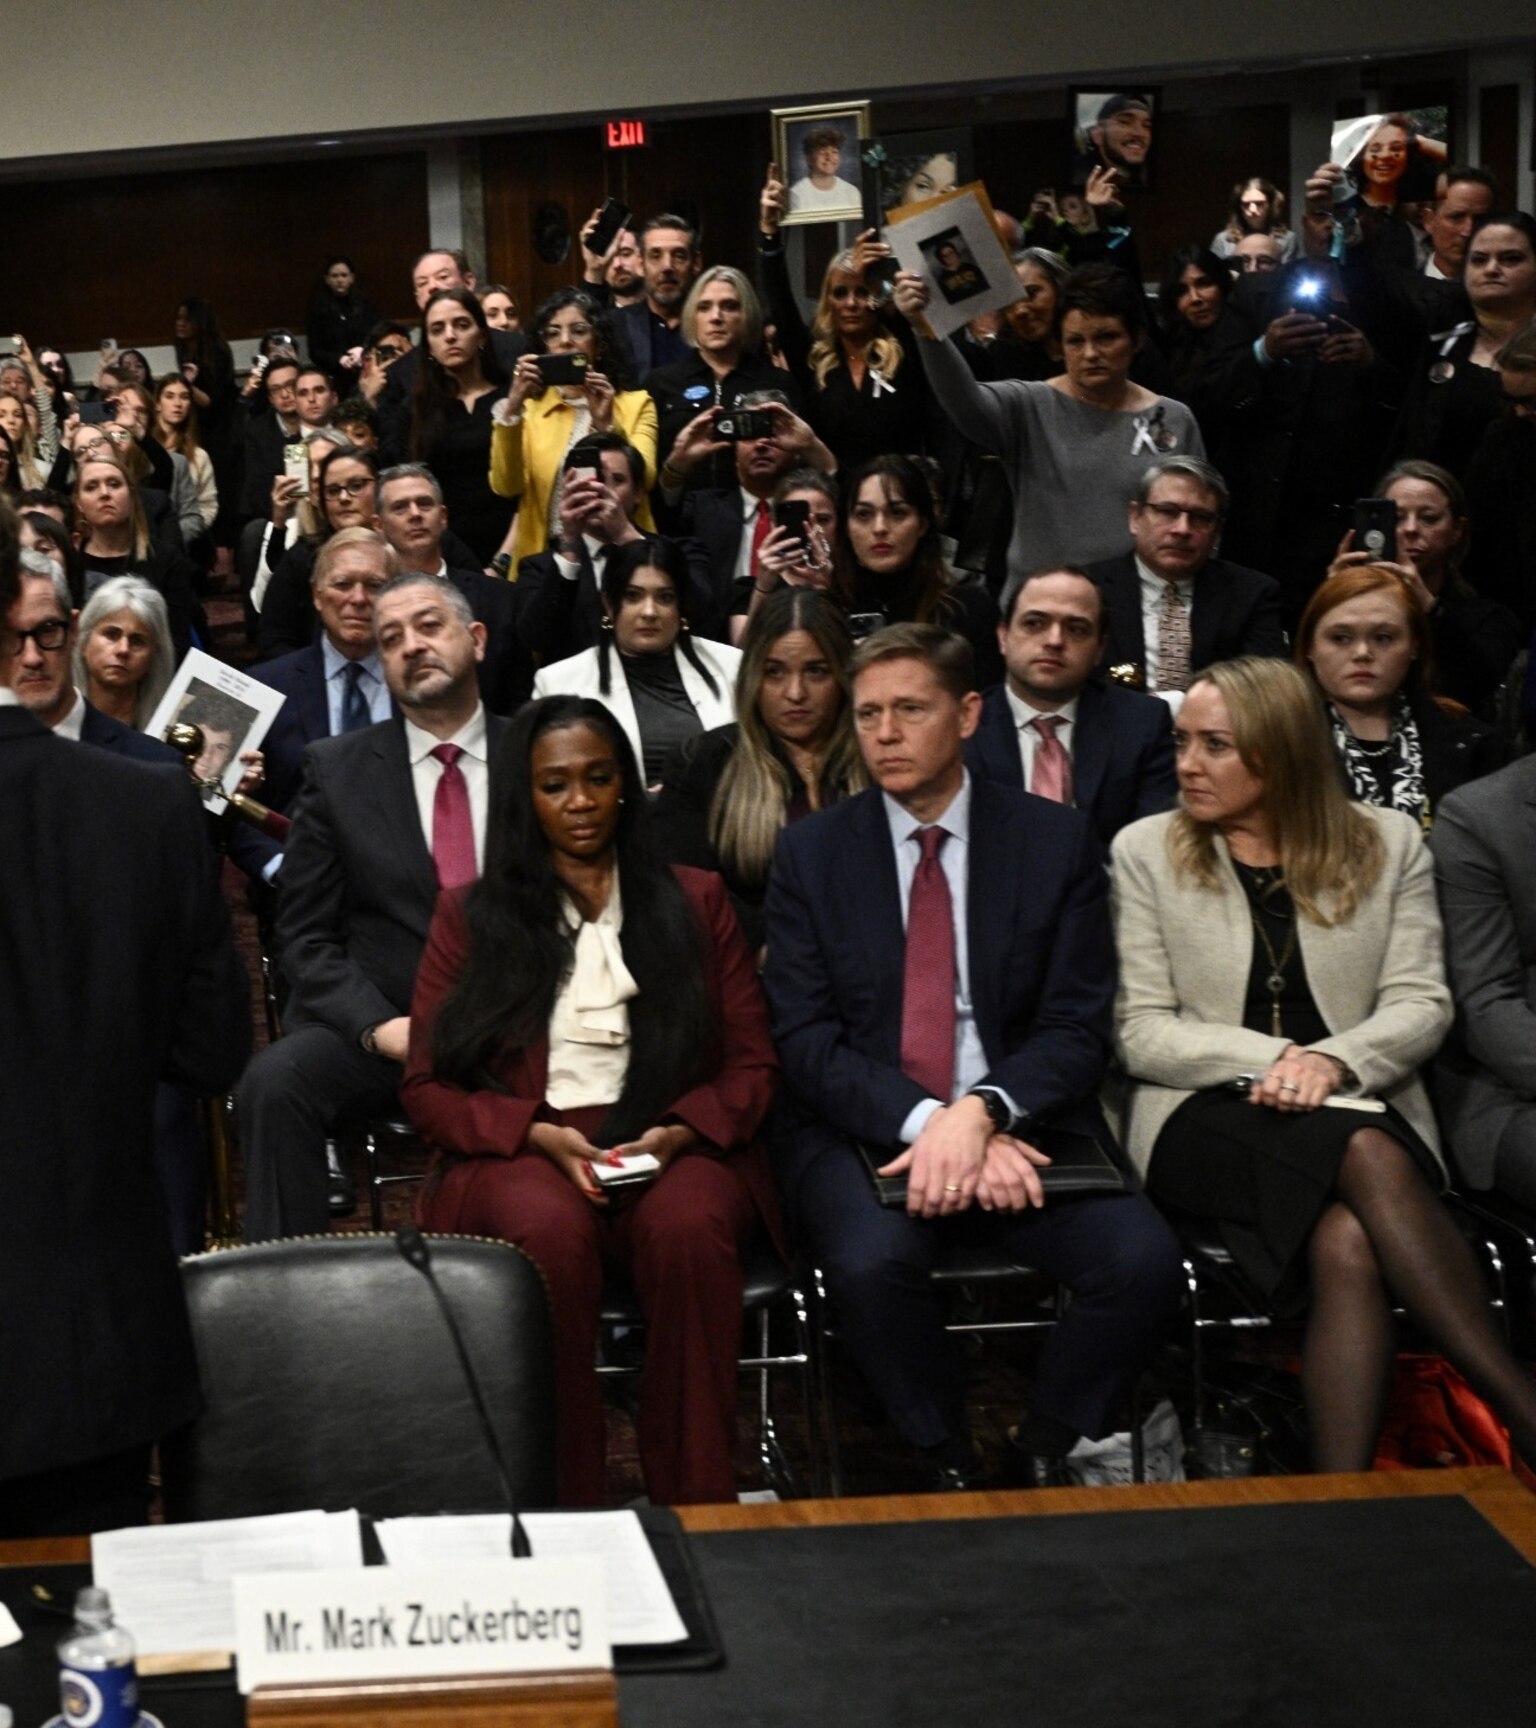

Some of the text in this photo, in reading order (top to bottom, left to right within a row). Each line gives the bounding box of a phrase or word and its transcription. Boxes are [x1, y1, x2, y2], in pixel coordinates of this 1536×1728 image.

[607, 121, 644, 147] EXIT
[265, 1598, 582, 1652] Mr. Mark Zuckerberg
